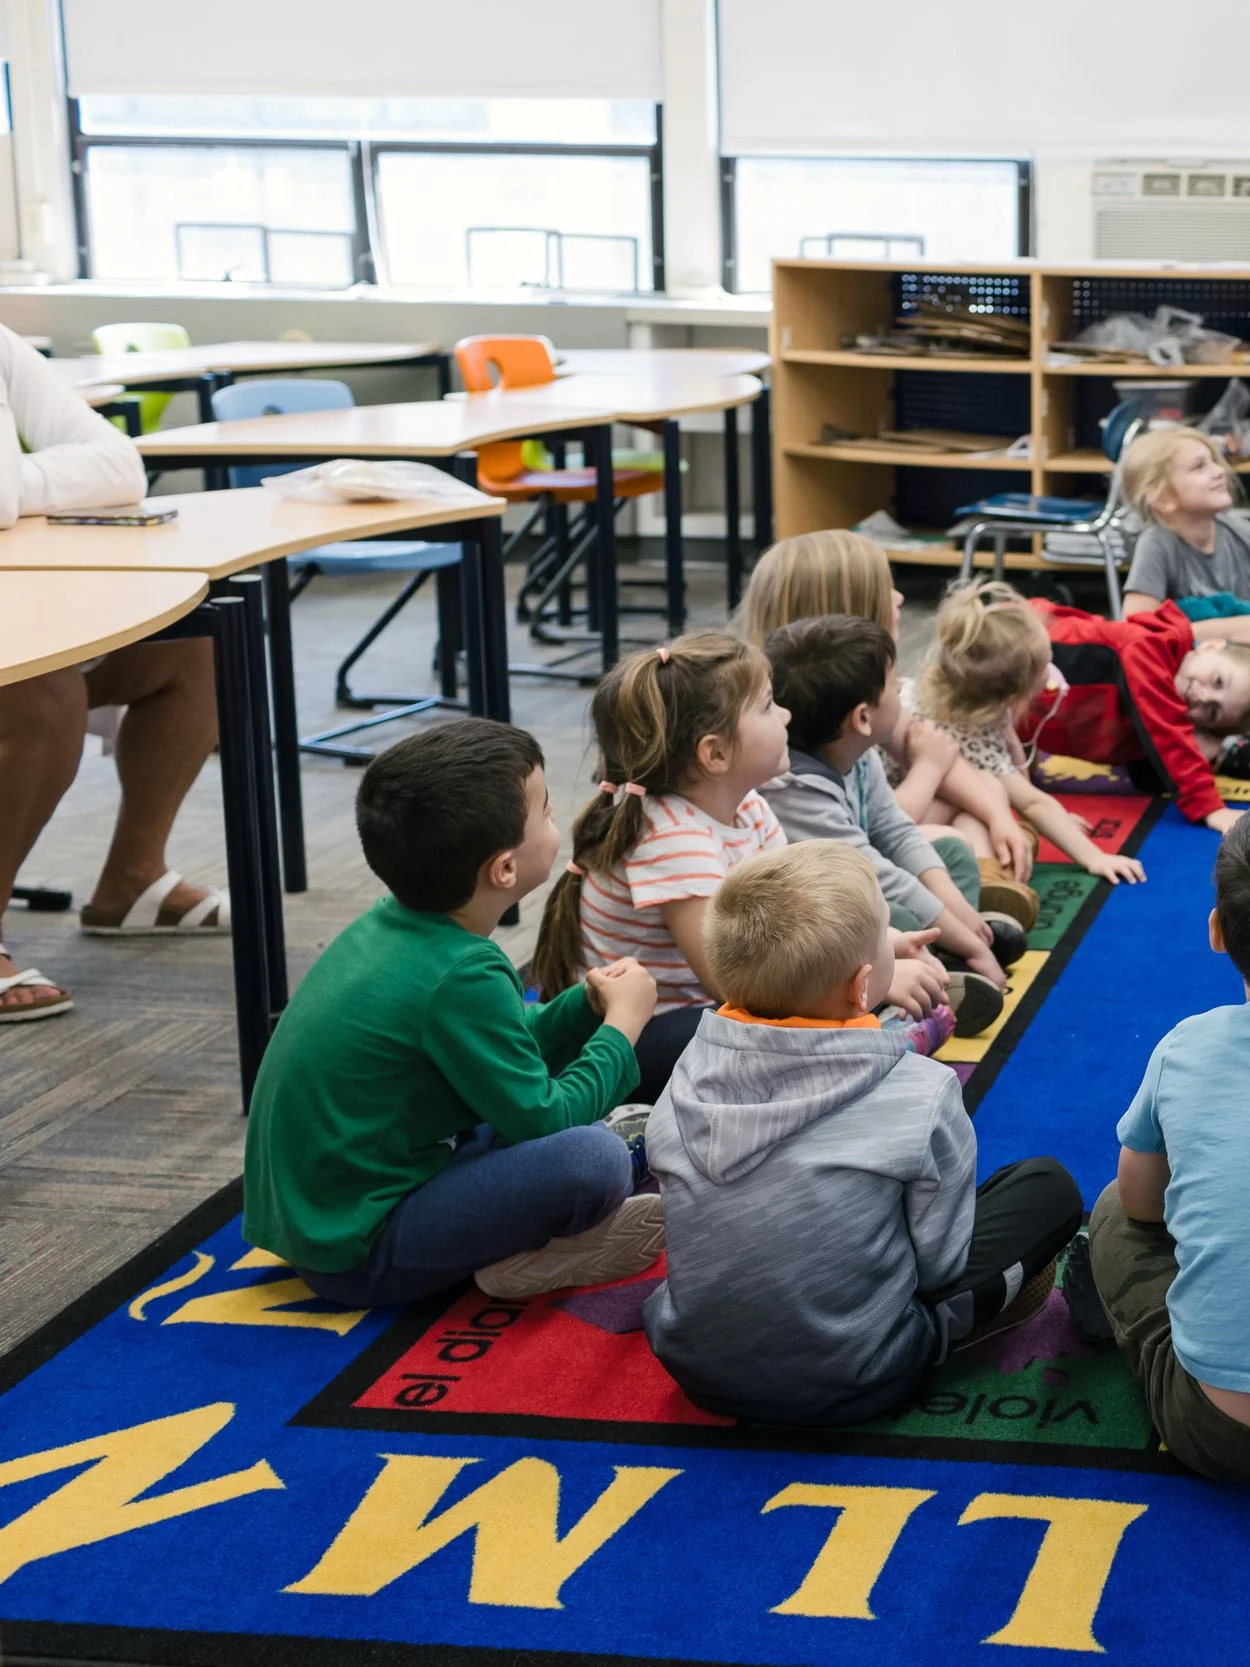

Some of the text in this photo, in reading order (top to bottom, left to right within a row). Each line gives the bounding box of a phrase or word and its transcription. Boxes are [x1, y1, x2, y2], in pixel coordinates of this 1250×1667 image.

[393, 1296, 531, 1408] el dia
[910, 1392, 1100, 1430] viole
[278, 1453, 685, 1610] M
